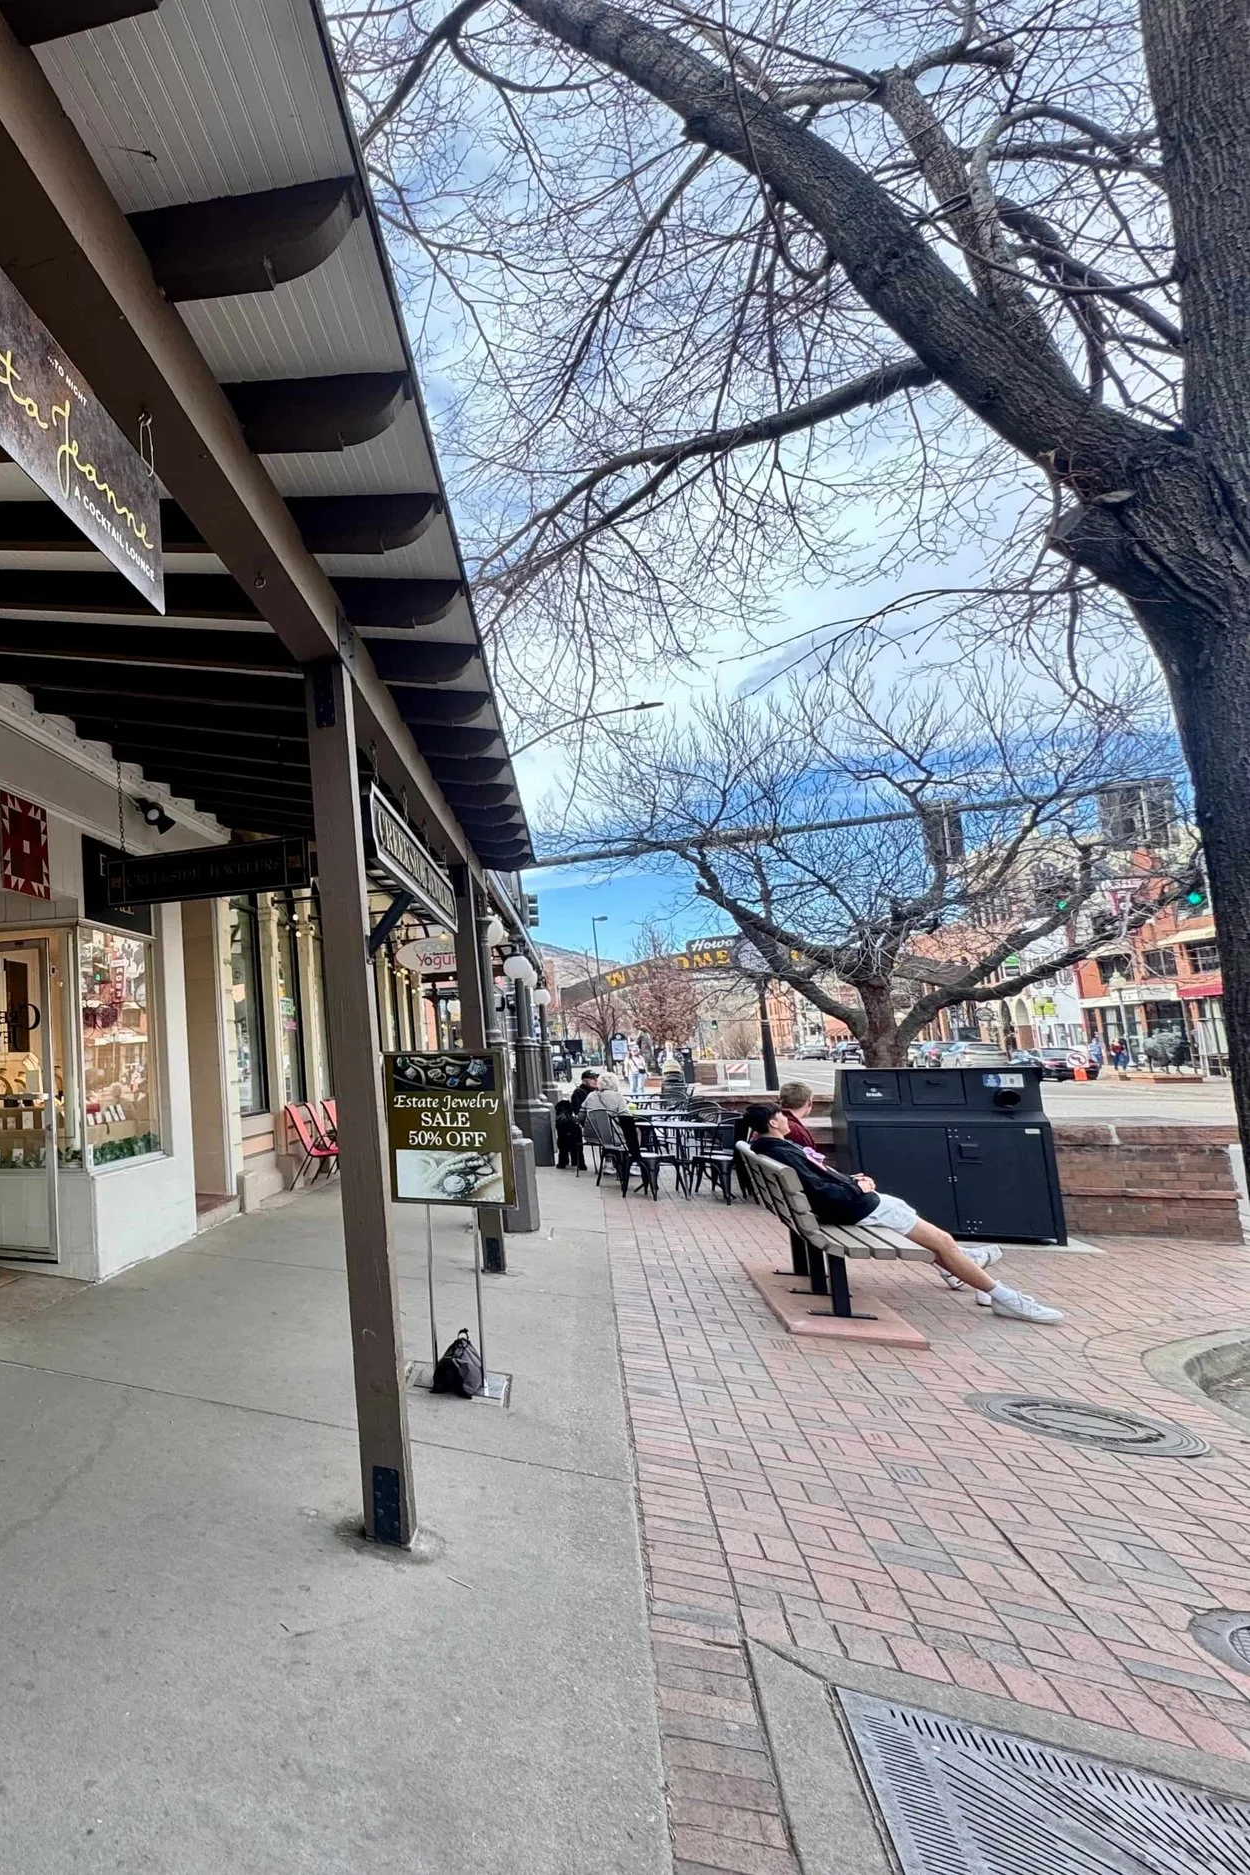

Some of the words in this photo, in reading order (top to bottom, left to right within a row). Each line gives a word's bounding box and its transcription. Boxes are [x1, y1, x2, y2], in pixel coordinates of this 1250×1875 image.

[52, 400, 153, 549] Jeanne
[74, 485, 81, 501] A
[83, 495, 124, 548] COCKTAIL
[125, 541, 155, 582] LOUNGE
[393, 1094, 439, 1109] Estate
[441, 1091, 500, 1115] Jewelry
[420, 1111, 471, 1128] SALE
[408, 1130, 443, 1146] 50%
[445, 1131, 487, 1147] OFF
